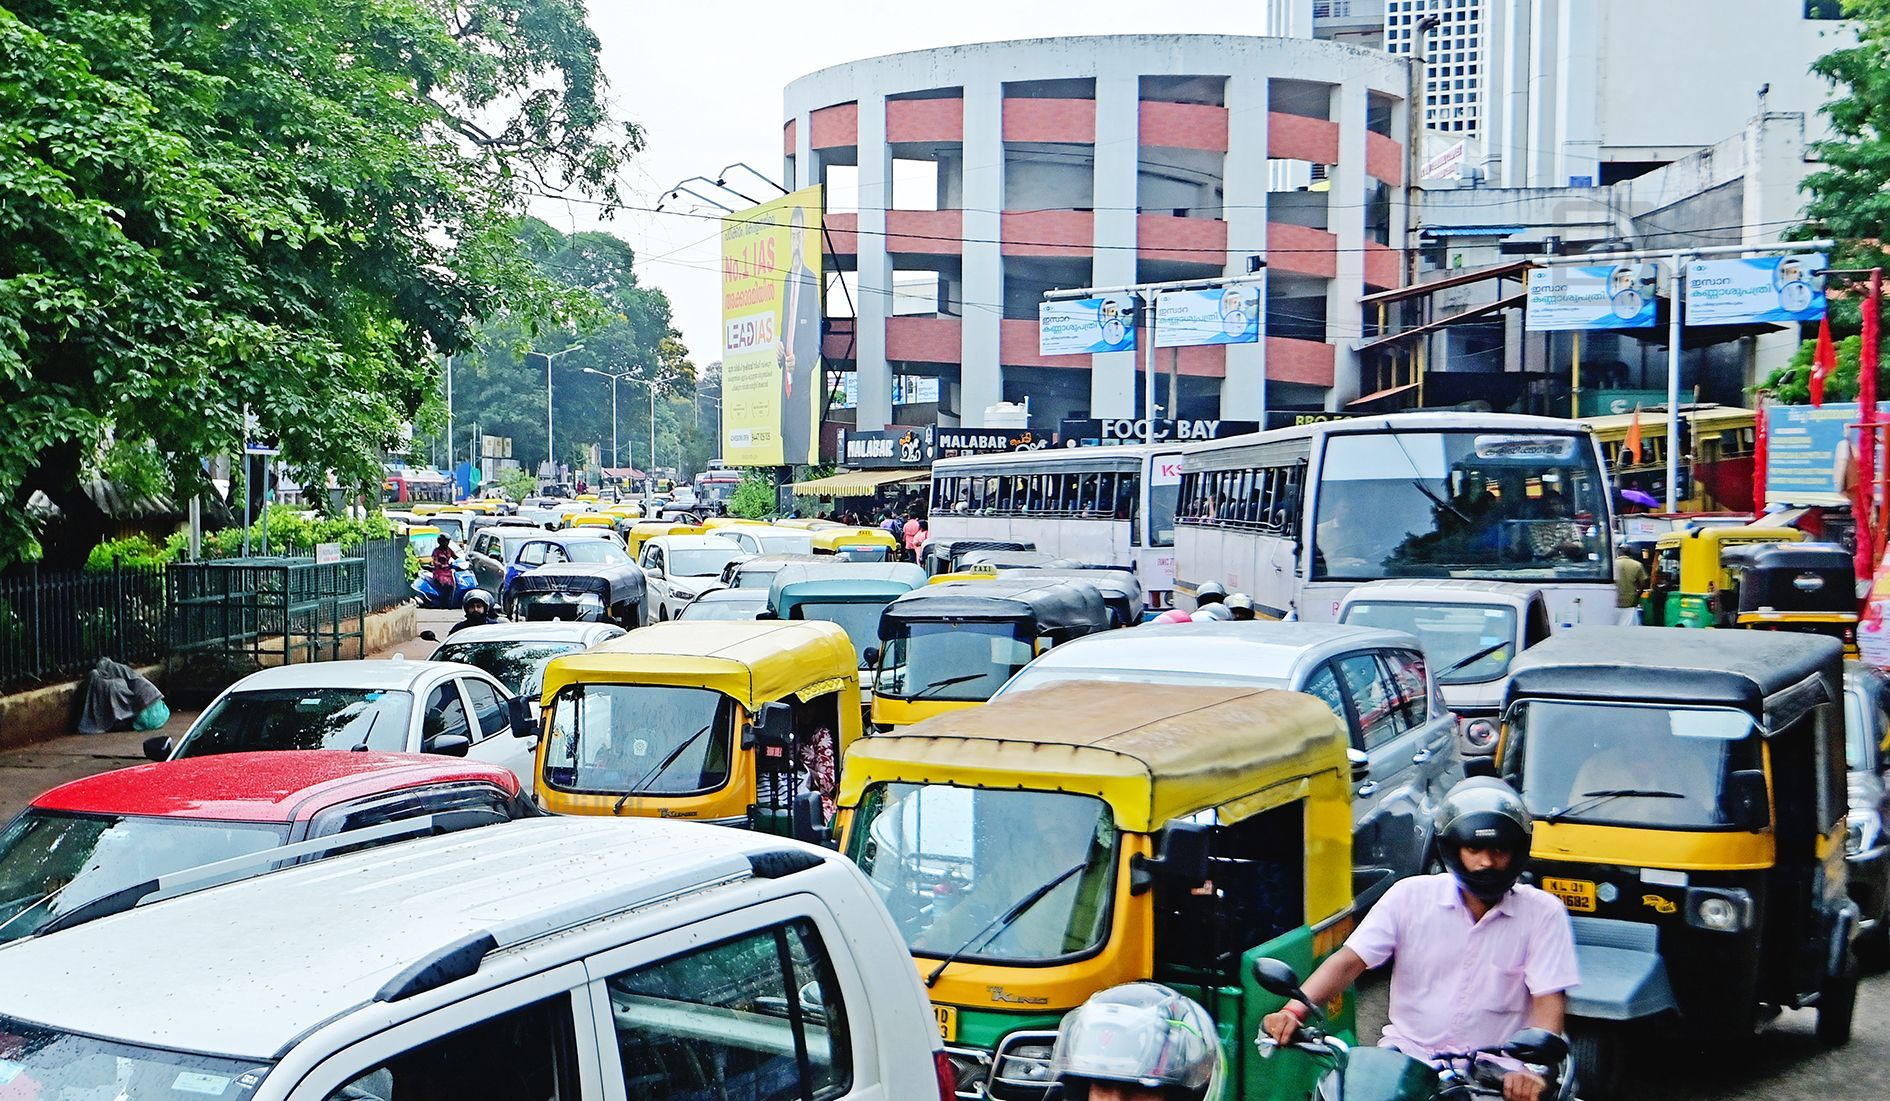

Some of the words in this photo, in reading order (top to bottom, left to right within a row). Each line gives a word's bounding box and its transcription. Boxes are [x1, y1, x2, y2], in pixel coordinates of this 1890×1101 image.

[753, 236, 775, 277] IAS
[1177, 419, 1220, 439] BAY
[847, 439, 895, 459] MALABAR
[940, 434, 1008, 449] MALABAR
[1550, 880, 1567, 892] KL
[991, 992, 1048, 1005] KING
